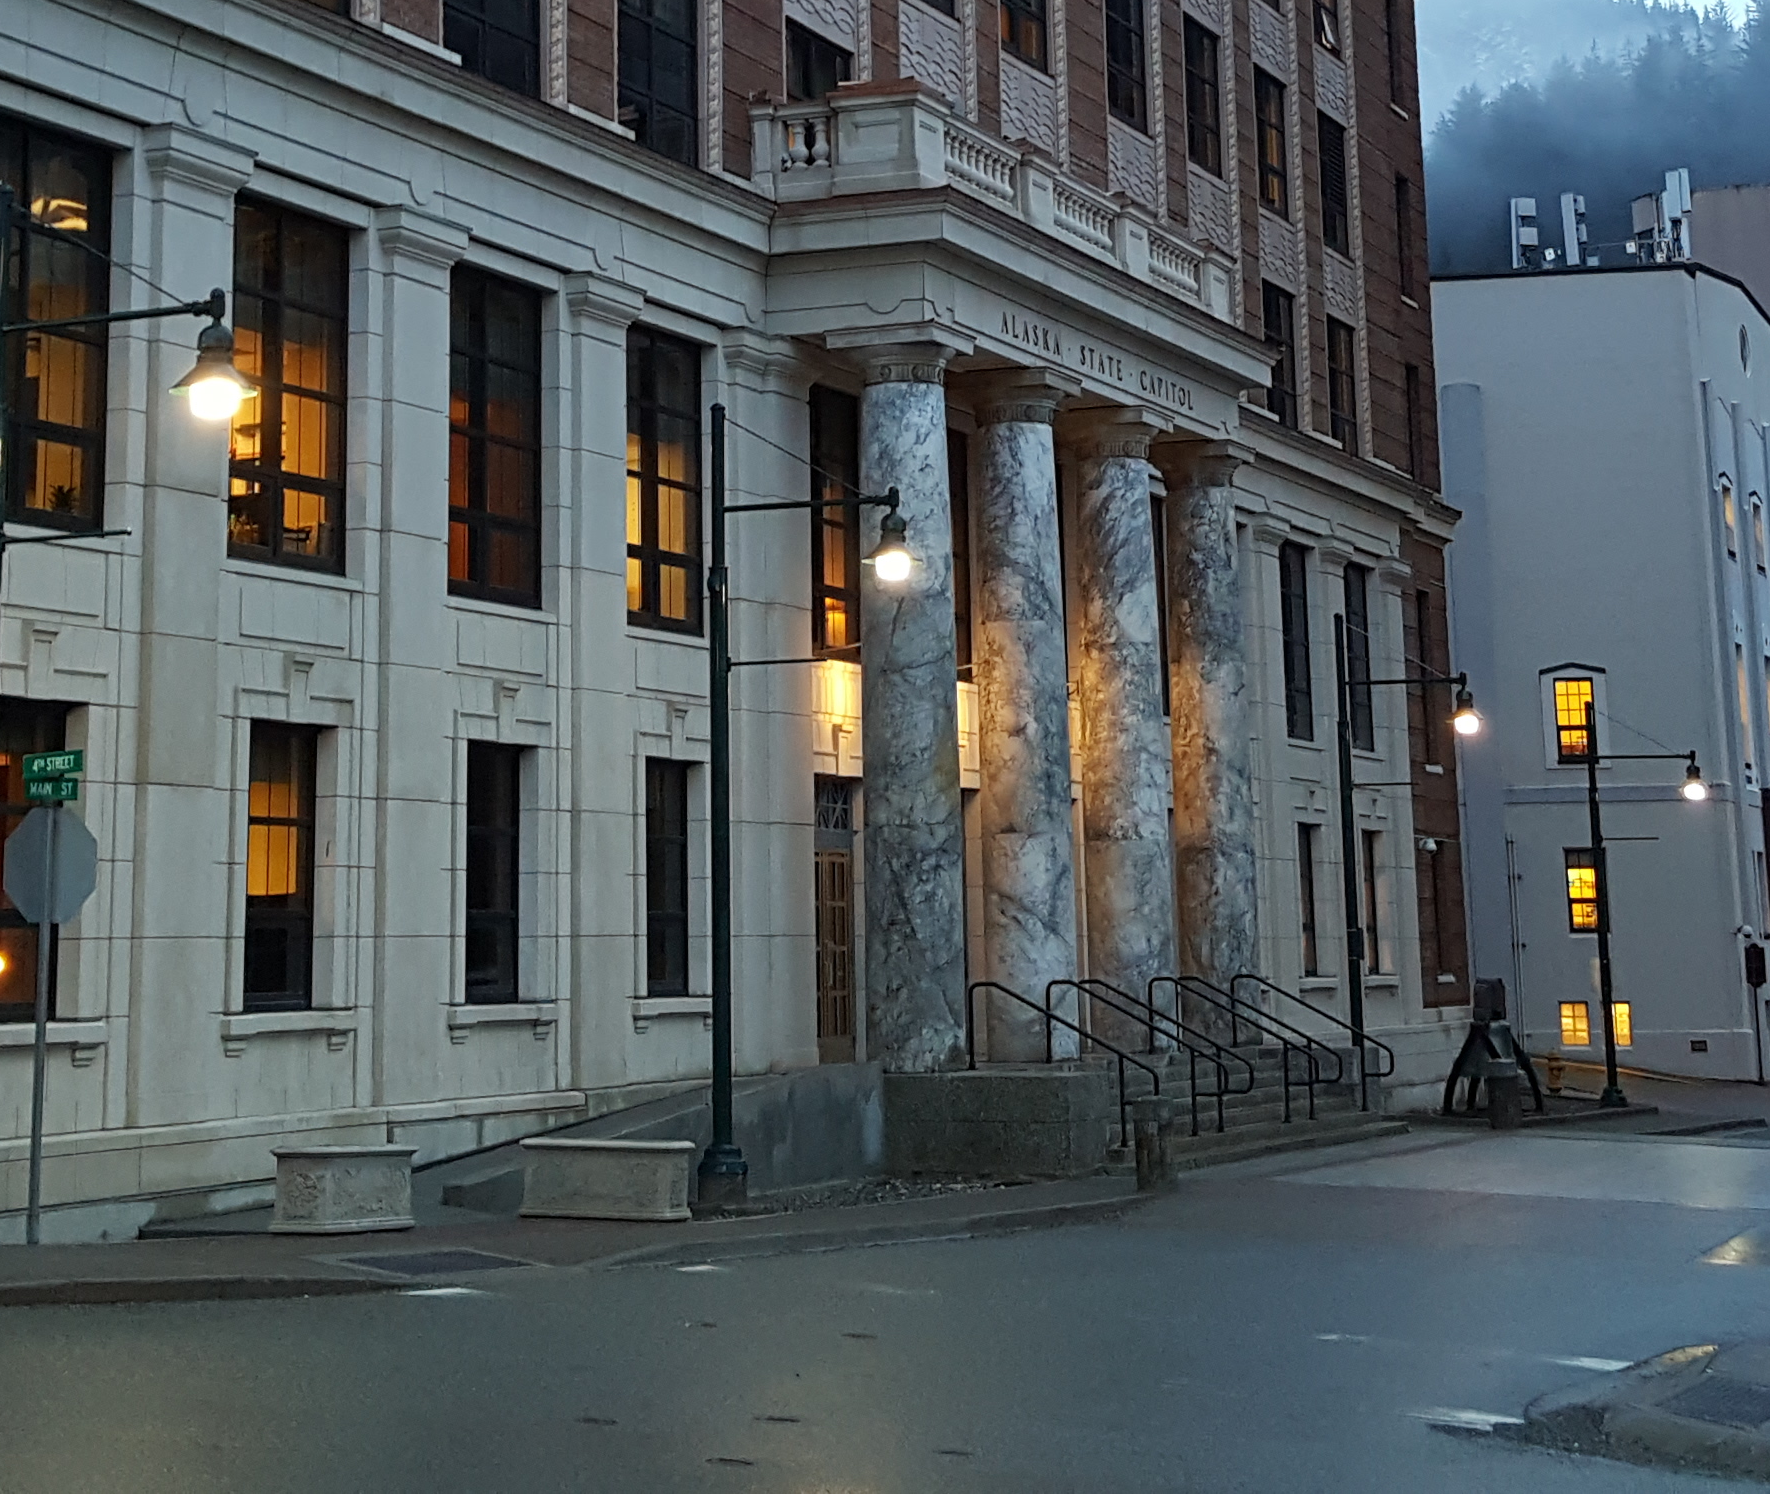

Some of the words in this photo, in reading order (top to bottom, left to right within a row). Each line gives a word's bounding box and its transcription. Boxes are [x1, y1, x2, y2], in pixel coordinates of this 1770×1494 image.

[1000, 311, 1061, 357] ALASKA
[1079, 344, 1123, 382] STATE
[1139, 370, 1194, 411] CAPITOL
[46, 754, 75, 771] STREET
[30, 782, 53, 796] MAIN
[61, 781, 73, 796] ST
